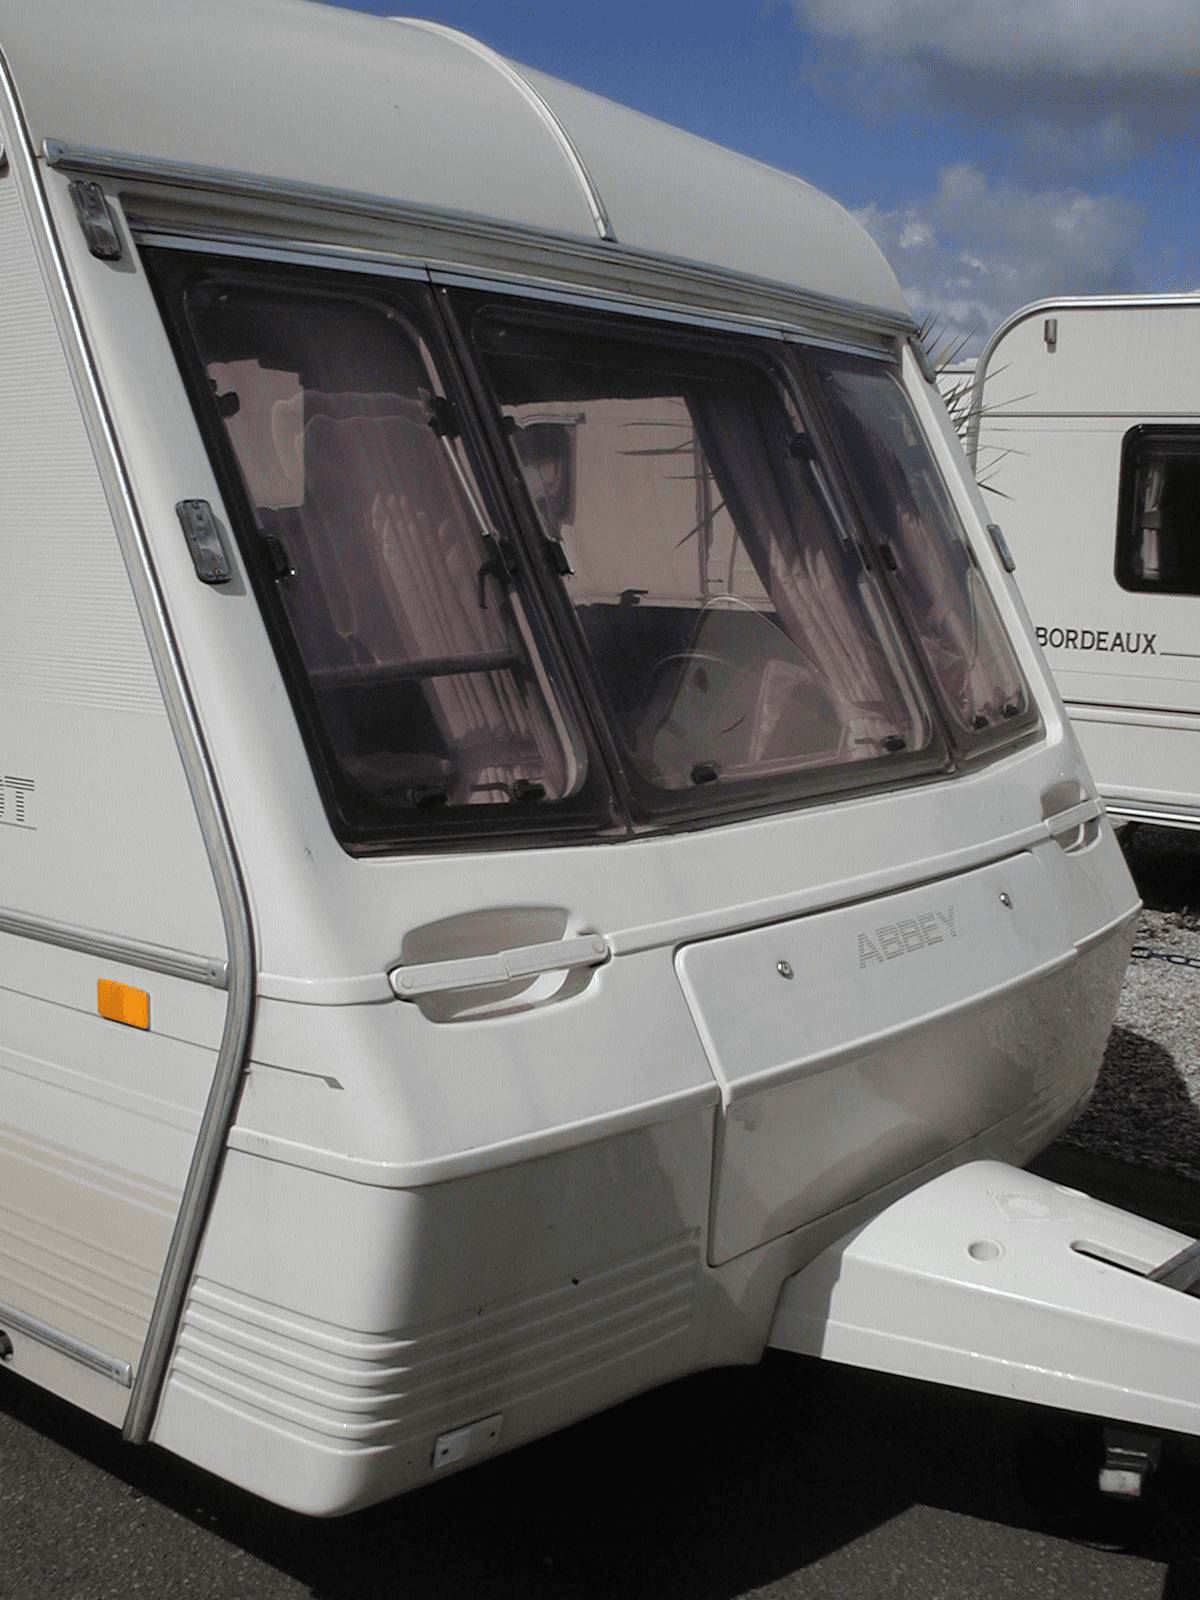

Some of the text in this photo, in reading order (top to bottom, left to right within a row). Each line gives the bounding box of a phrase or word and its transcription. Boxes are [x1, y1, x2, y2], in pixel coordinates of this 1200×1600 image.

[1035, 626, 1157, 655] BORDEAUX
[0, 774, 36, 823] T
[858, 906, 957, 970] ABBEY
